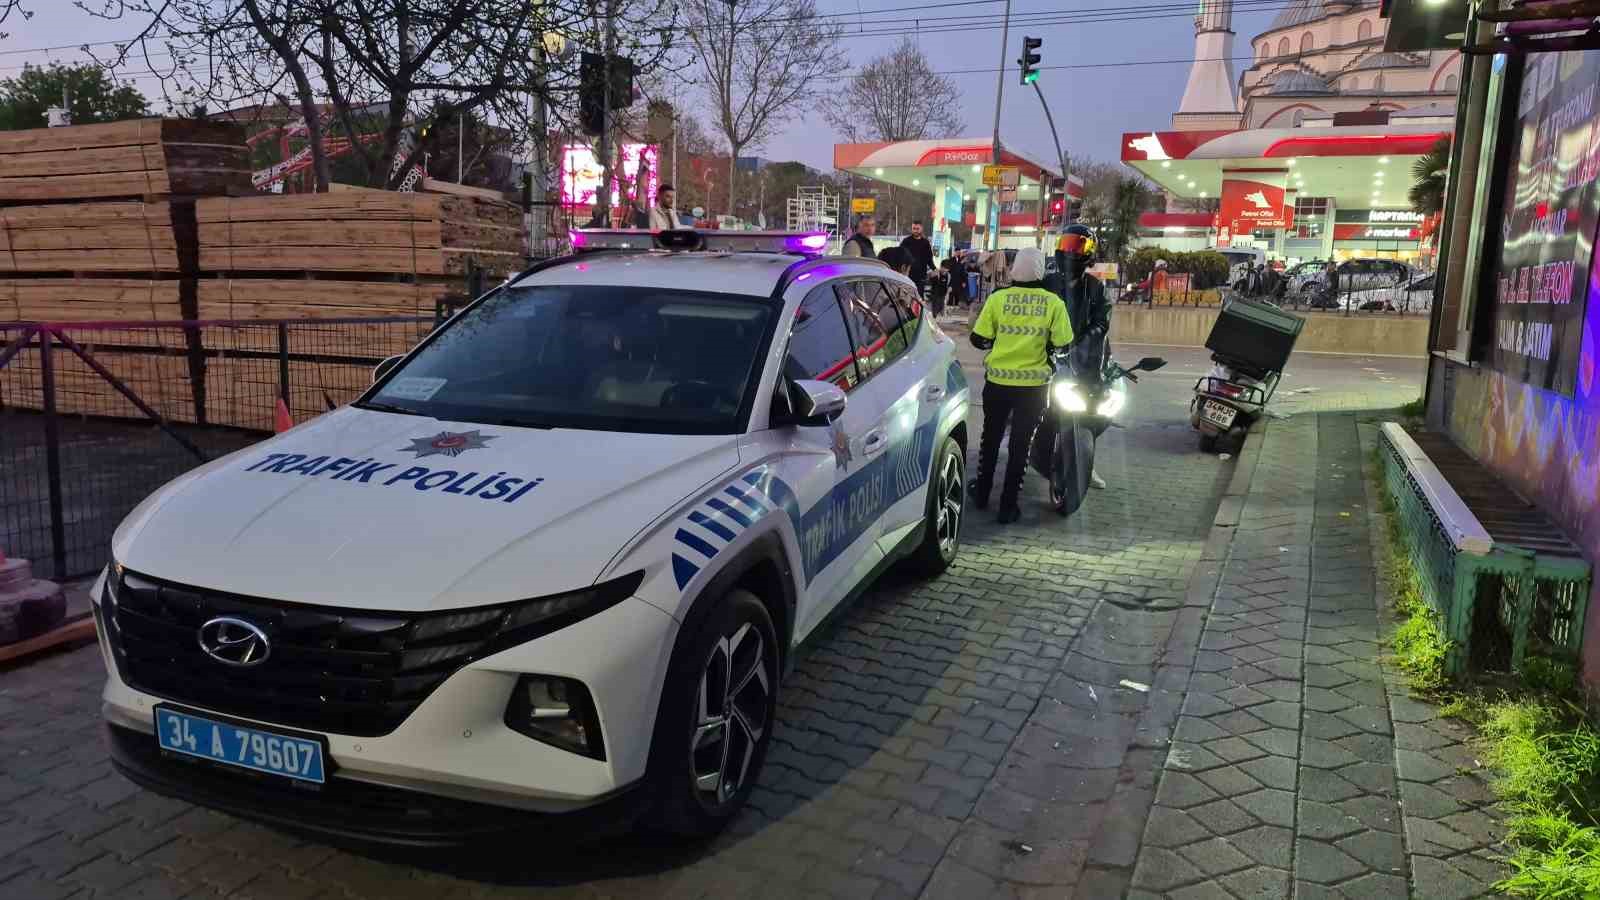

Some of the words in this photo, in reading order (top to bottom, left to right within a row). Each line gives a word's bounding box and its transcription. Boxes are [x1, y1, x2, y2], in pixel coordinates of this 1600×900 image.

[245, 453, 397, 483] TRAFİK
[383, 466, 545, 503] POLİSİ
[168, 715, 197, 751] 34
[212, 725, 225, 758] A
[235, 730, 314, 776] 79607
